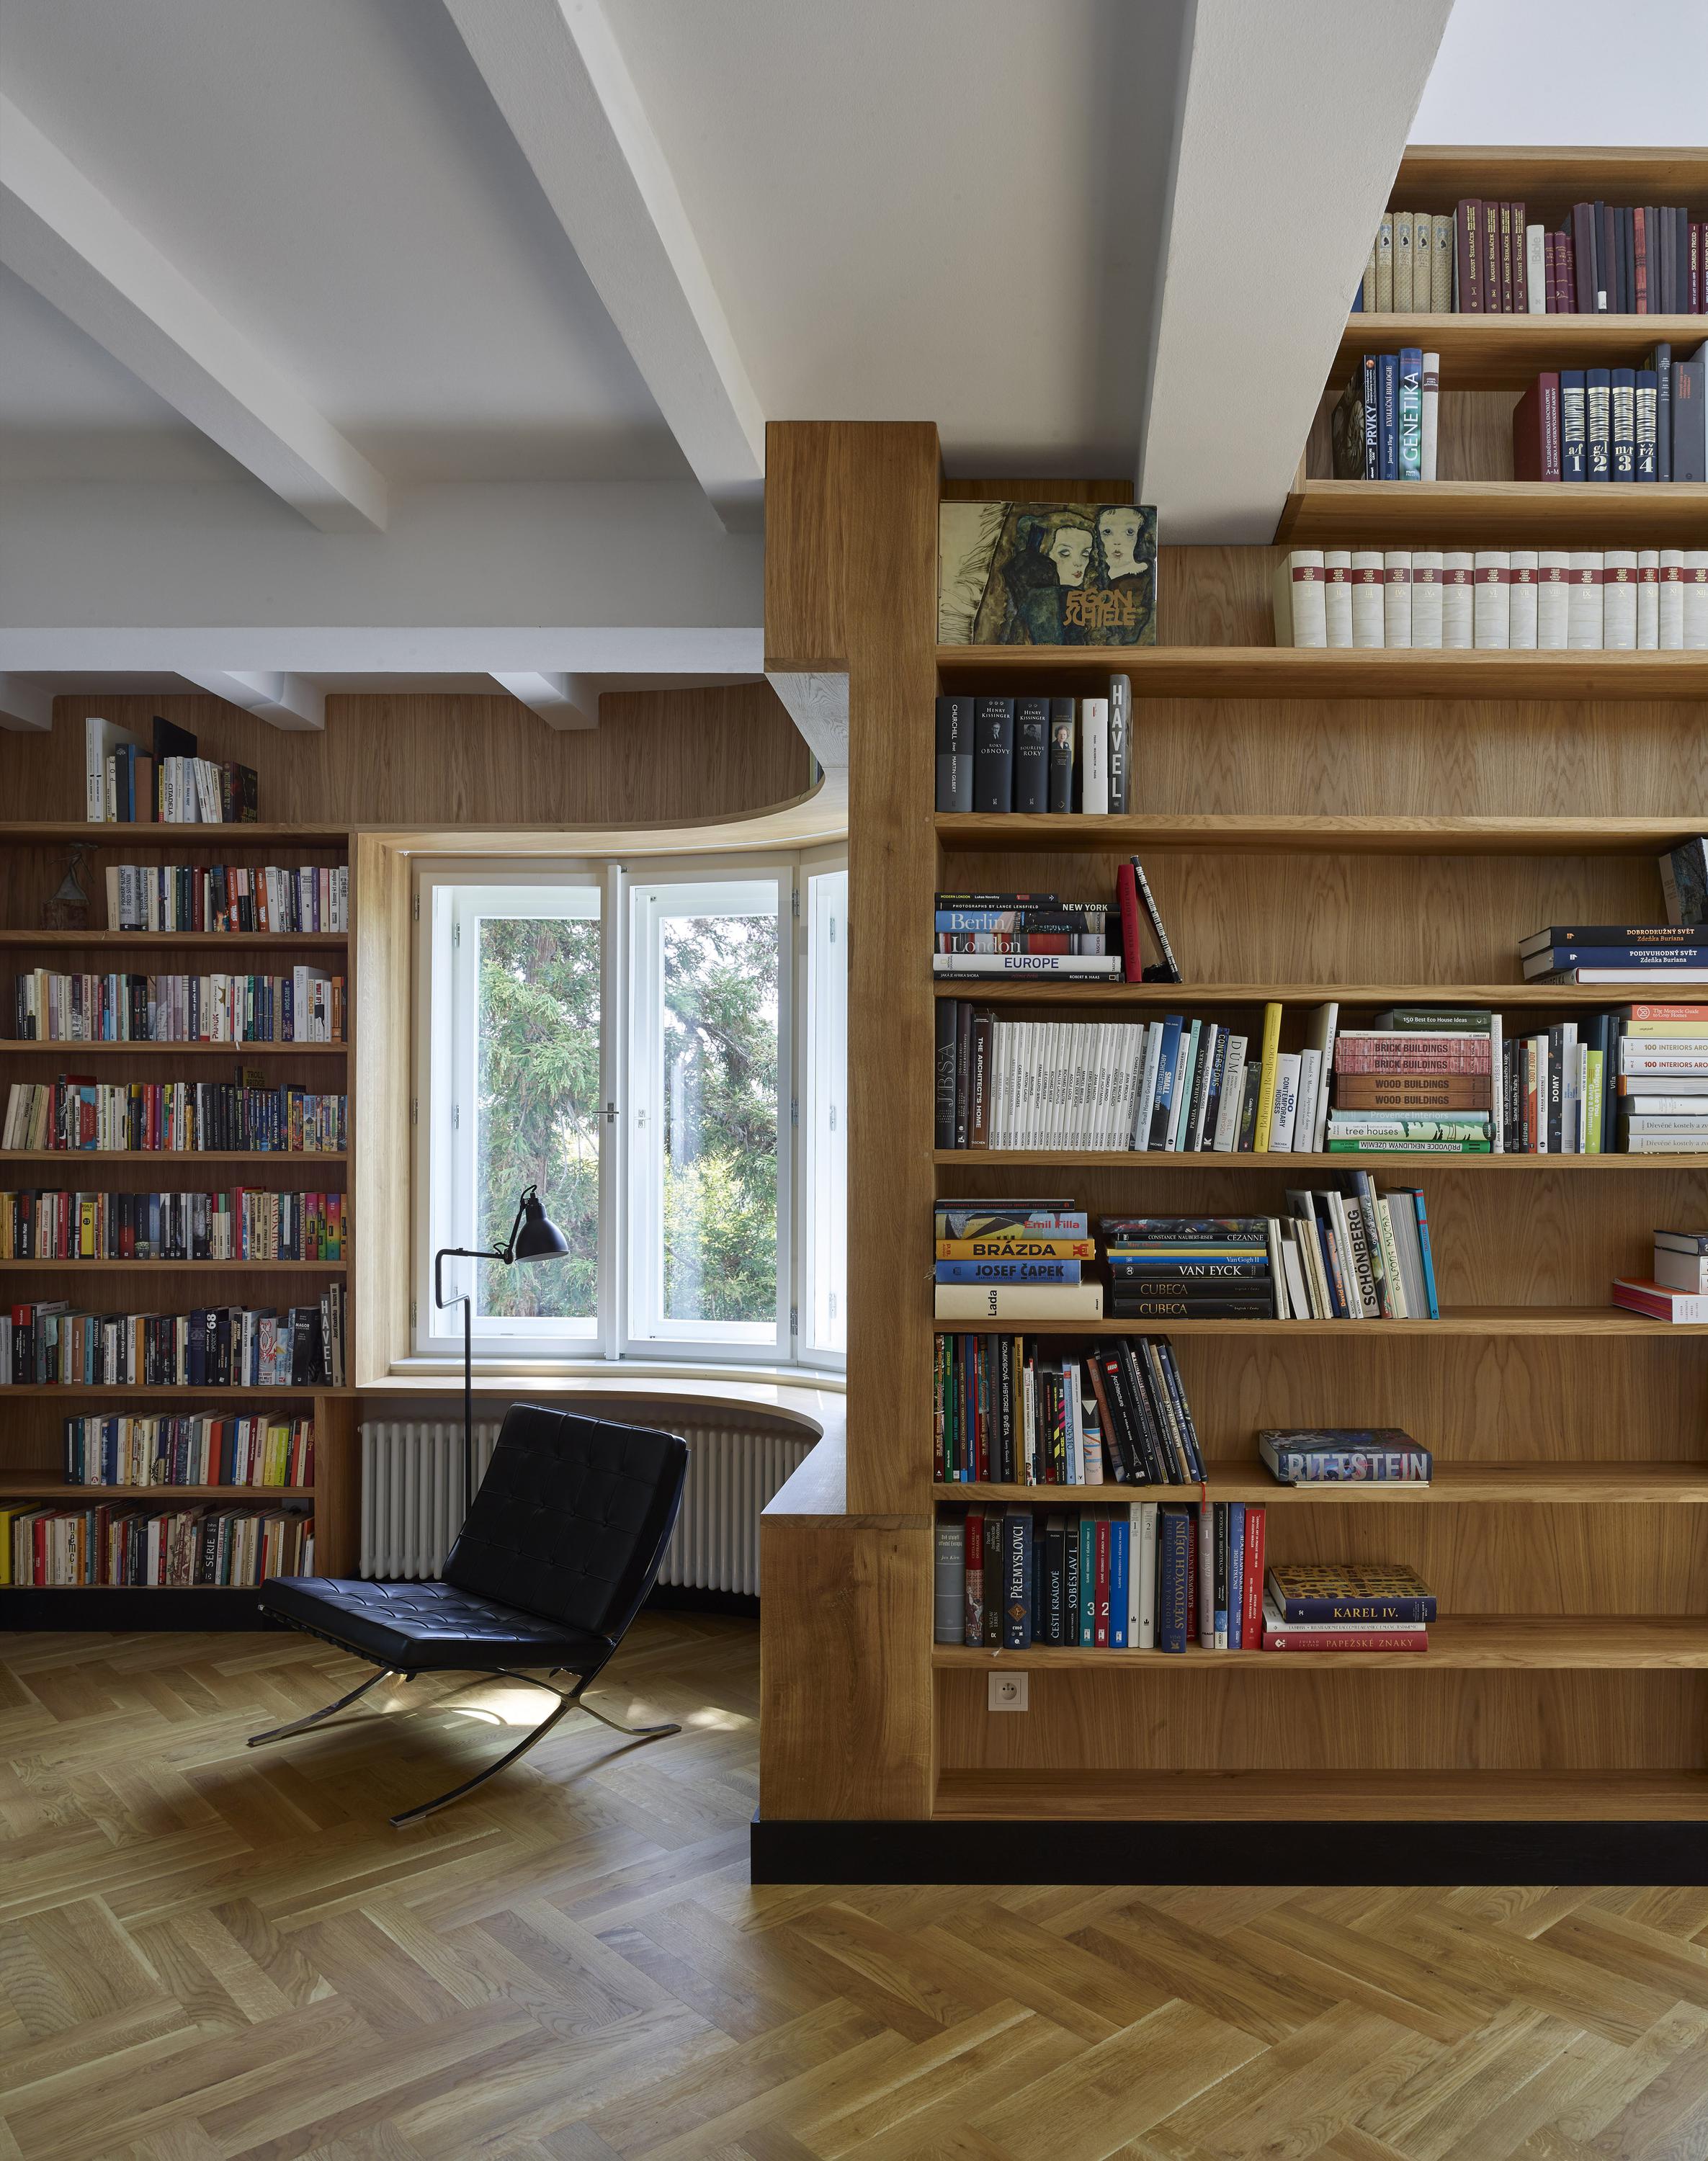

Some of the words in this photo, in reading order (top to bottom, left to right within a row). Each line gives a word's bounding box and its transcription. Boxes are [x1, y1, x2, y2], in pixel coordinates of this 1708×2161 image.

[1385, 396, 1393, 426] EVOLUČNÍ
[1403, 372, 1419, 461] GENETIKA
[1564, 393, 1585, 442] ENCYKLOPEDIE
[1367, 406, 1377, 445] PRVKY
[1573, 456, 1582, 471] 1
[1593, 456, 1607, 472] 2
[1619, 456, 1632, 472] 3
[1640, 457, 1654, 473] 4
[1066, 586, 1134, 607] EGON
[1063, 604, 1136, 627] SCHIELE
[1112, 685, 1122, 797] HAVEL
[950, 913, 1006, 930] Berlin
[952, 935, 1021, 953] London
[1004, 957, 1060, 969] EUROPE
[1227, 1040, 1243, 1074] DŮM
[1374, 1043, 1402, 1053] BRICK
[1403, 1043, 1449, 1054] BUILDINGS
[1212, 1034, 1226, 1088] CONVERSIONS
[1264, 1044, 1276, 1086] Residence
[1156, 1053, 1166, 1095] ARCHITECTURE
[1162, 1071, 1173, 1095] SMALL
[1375, 1080, 1401, 1088] WOOD
[1404, 1080, 1449, 1088] BUILDINGS
[1192, 1075, 1202, 1104] ZAHRADY
[1153, 1095, 1162, 1111] NOW!
[1259, 1087, 1271, 1129] Bohemian
[1274, 1089, 1282, 1114] HOUSES
[1279, 1077, 1289, 1128] CONTEMPORARY
[1345, 1127, 1364, 1136] tree
[1367, 1124, 1399, 1136] houses
[1673, 1122, 1696, 1130] kostely
[1361, 1142, 1387, 1150] ÚZEMÍM
[1387, 1142, 1426, 1151] NEKLIDNÝM
[1427, 1142, 1461, 1151] PRŮVODCE
[1365, 1202, 1374, 1220] PABLO
[1024, 1220, 1051, 1229] Emil
[1055, 1220, 1080, 1229] Filla
[1368, 1222, 1377, 1245] PICASSO
[1382, 1215, 1395, 1247] MUCHA
[973, 1240, 1056, 1256] BRÁZDA
[1227, 1232, 1264, 1241] CÉZANNE
[1347, 1209, 1377, 1306] SCHÖNBERG
[1387, 1251, 1400, 1282] ALFONS
[975, 1266, 1016, 1276] JOSEF
[1020, 1263, 1065, 1276] ČAPEK
[1179, 1266, 1205, 1275] VAN
[1210, 1266, 1243, 1275] EYCK
[988, 1290, 997, 1317] Lada
[1140, 1303, 1188, 1314] CUBECA
[321, 1300, 332, 1375] HAVEL
[1107, 1363, 1119, 1372] LEGO
[1111, 1374, 1125, 1408] Architecture
[1288, 1454, 1427, 1481] RITTSTEIN
[1174, 1521, 1186, 1555] DĚJIN
[205, 1538, 215, 1567] SÉRIE
[1010, 1526, 1024, 1599] PŘEMYSLOVCI
[1050, 1570, 1060, 1610] KRÁLOVÉ
[1068, 1556, 1078, 1609] SOBĚSLAV
[1173, 1560, 1185, 1629] SVĚTOVÝCH
[1333, 1608, 1378, 1618] KAREL
[1382, 1608, 1398, 1618] IV.
[1050, 1613, 1060, 1639] ČEŠTÍ
[1326, 1637, 1374, 1648] PAPEŽSKÉ
[1379, 1638, 1414, 1647] ZNAKY
